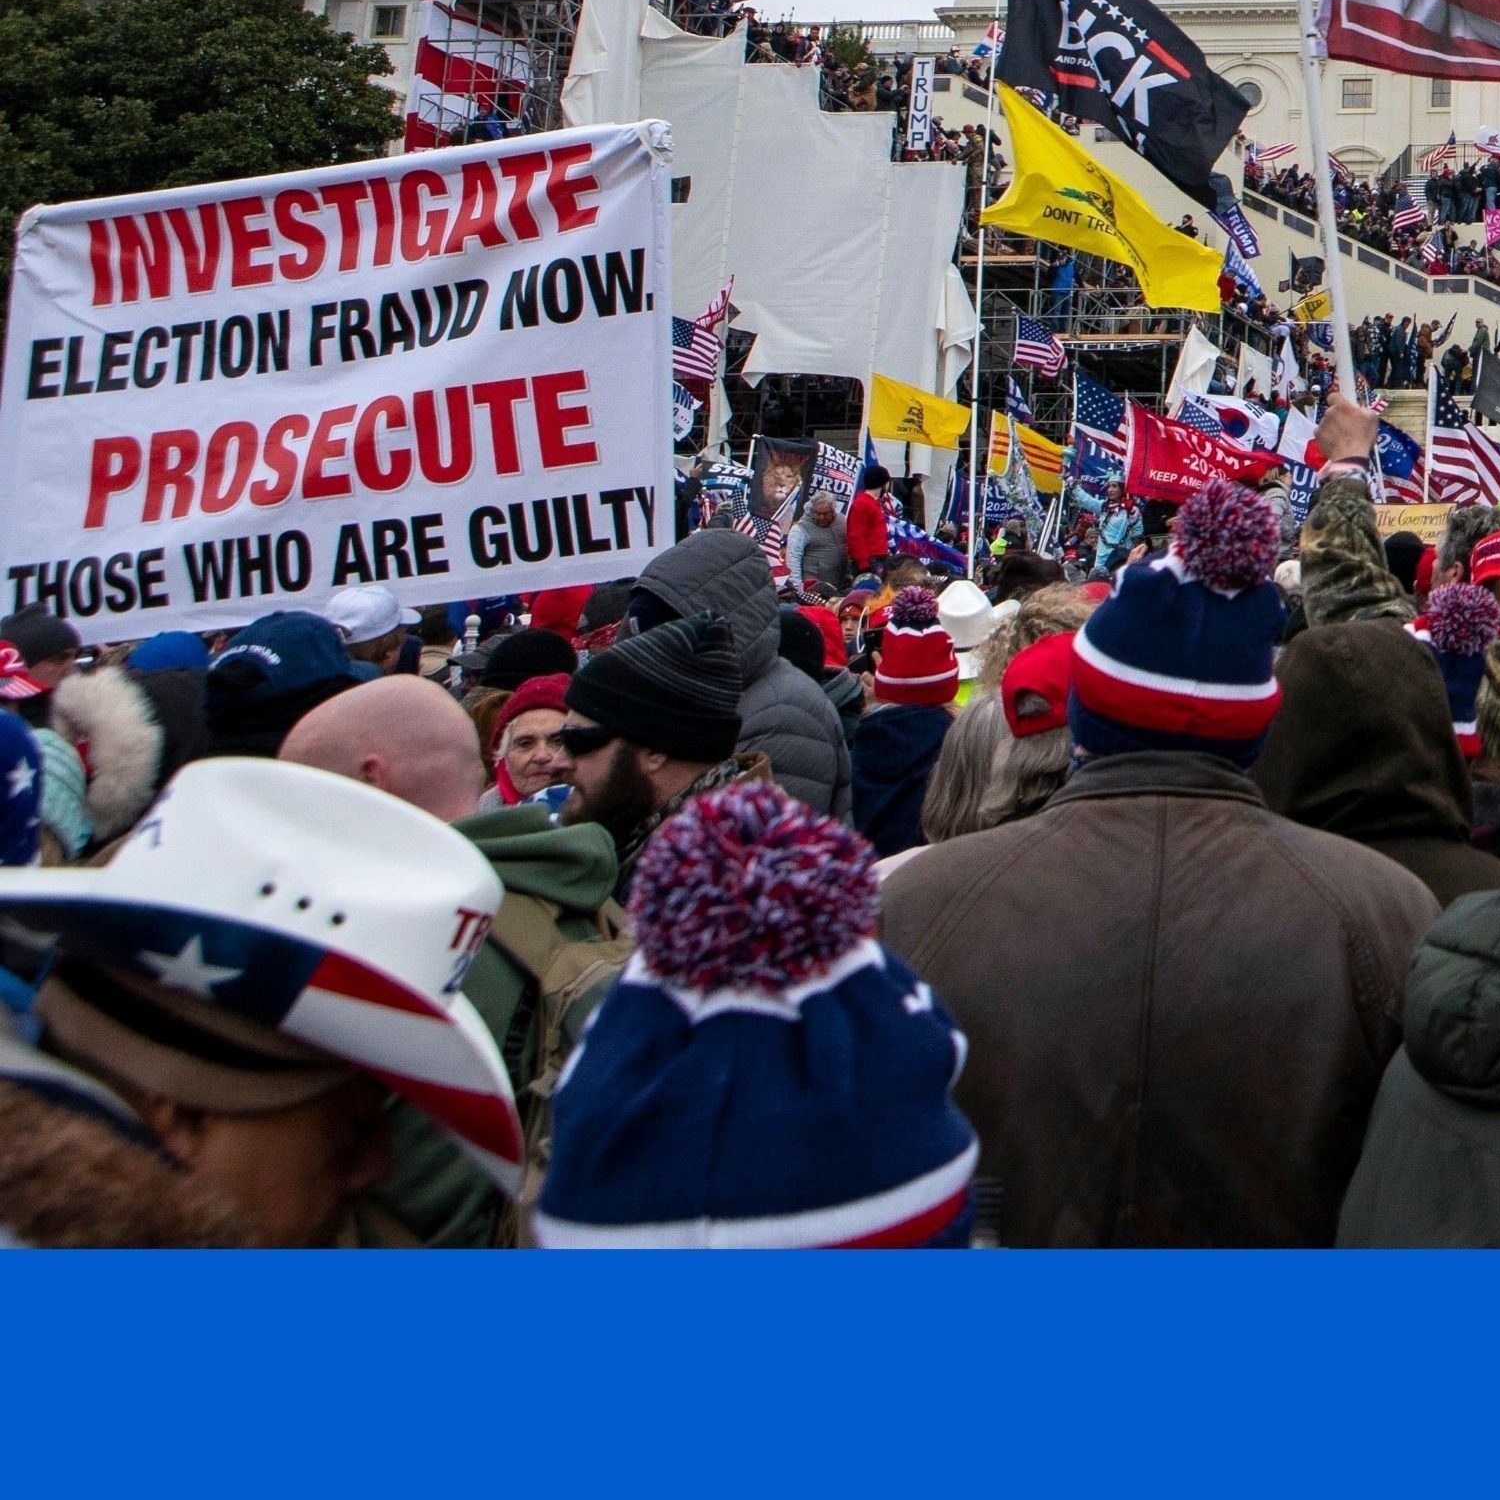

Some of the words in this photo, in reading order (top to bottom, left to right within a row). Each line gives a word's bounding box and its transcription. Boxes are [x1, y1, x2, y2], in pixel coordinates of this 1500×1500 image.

[1054, 54, 1076, 66] AND
[910, 61, 931, 148] TRUMP
[86, 142, 600, 308] INVESTIGATE
[1226, 204, 1257, 257] TRUMP
[26, 308, 290, 400] ELECTION
[310, 278, 489, 367] FRAUD
[499, 247, 655, 331] NOW.
[82, 369, 601, 530] PROSECUTE
[1149, 469, 1178, 483] KEEP
[986, 500, 1013, 512] 2020
[1377, 510, 1397, 528] The
[8, 547, 169, 619] THOSE
[183, 530, 312, 603] WHO
[332, 513, 450, 586] ARE
[468, 485, 655, 568] GUILTY
